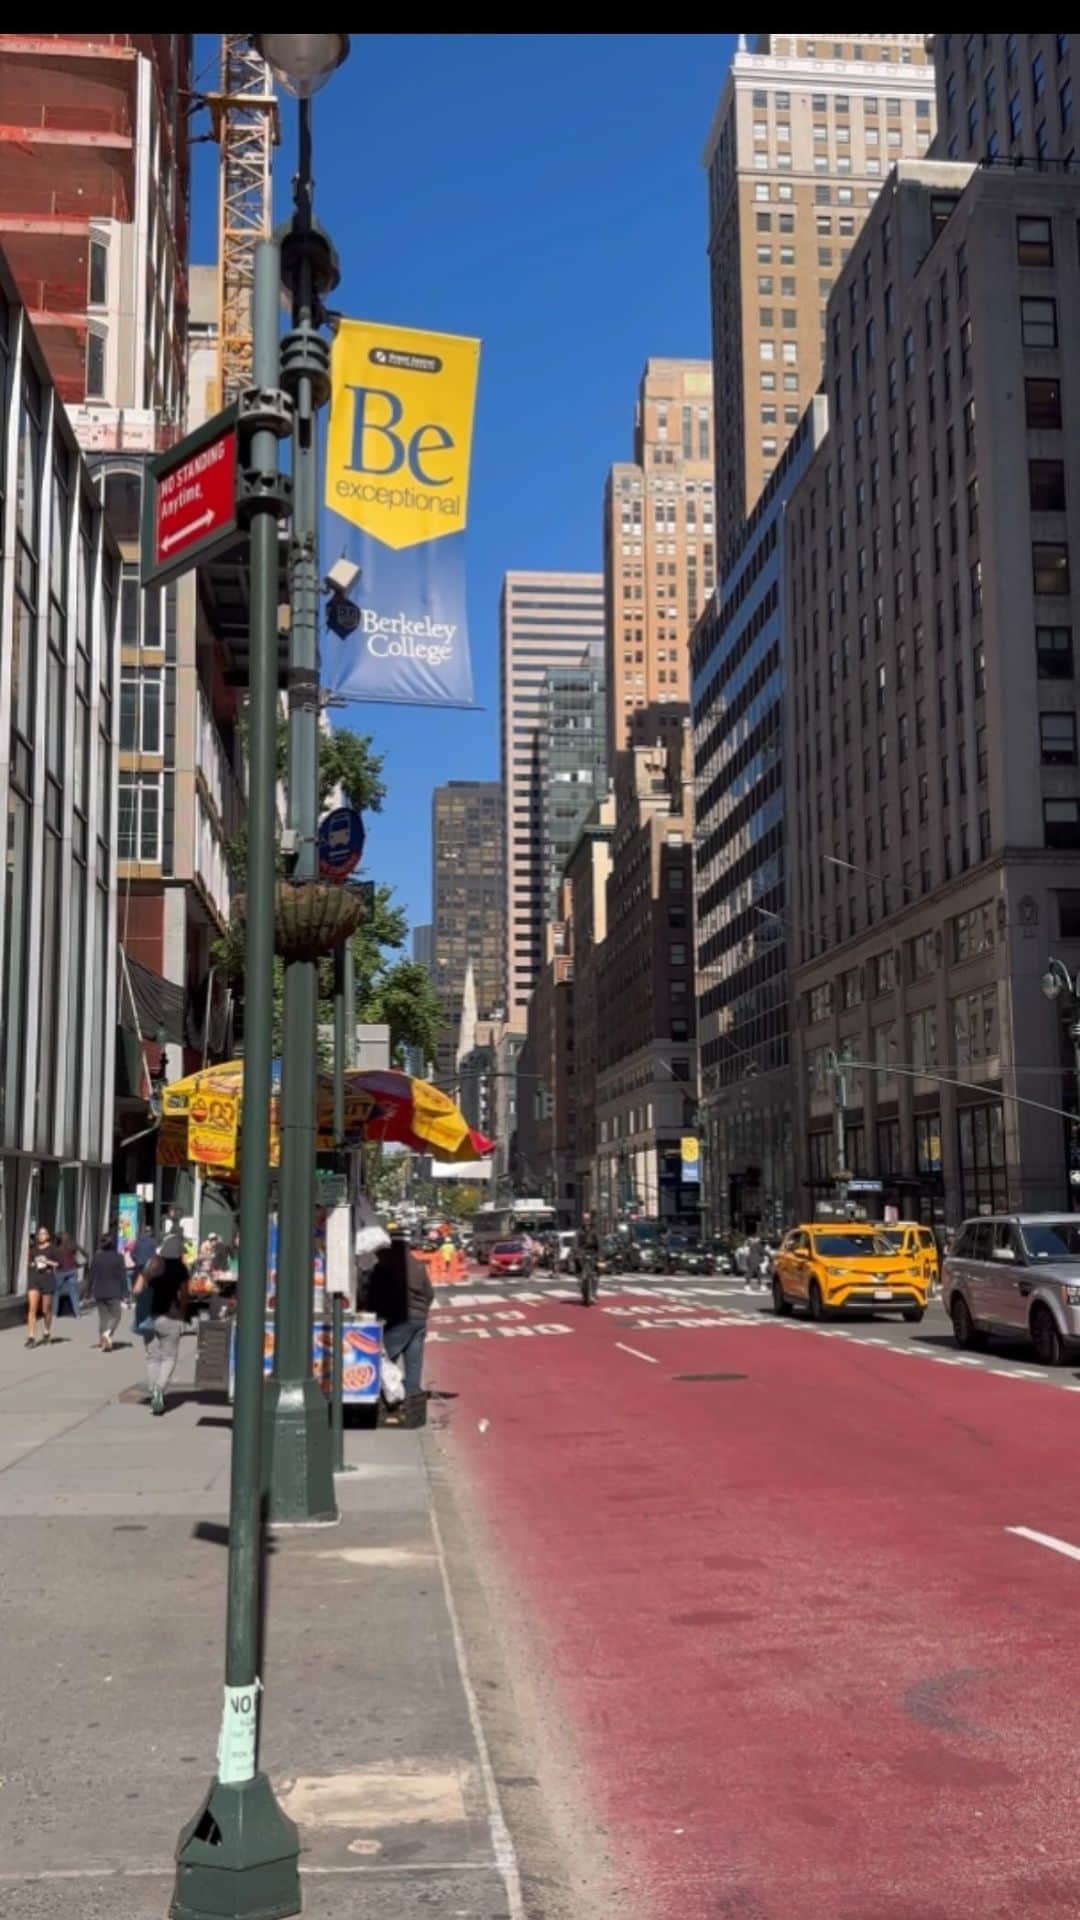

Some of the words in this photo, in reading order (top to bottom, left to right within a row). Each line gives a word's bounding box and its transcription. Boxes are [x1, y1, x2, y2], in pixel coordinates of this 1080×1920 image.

[343, 384, 455, 487] Be
[160, 474, 176, 497] NO
[177, 440, 226, 487] STANDING
[336, 479, 461, 516] exceptional
[362, 608, 457, 645] Berkeley
[367, 633, 453, 665] College
